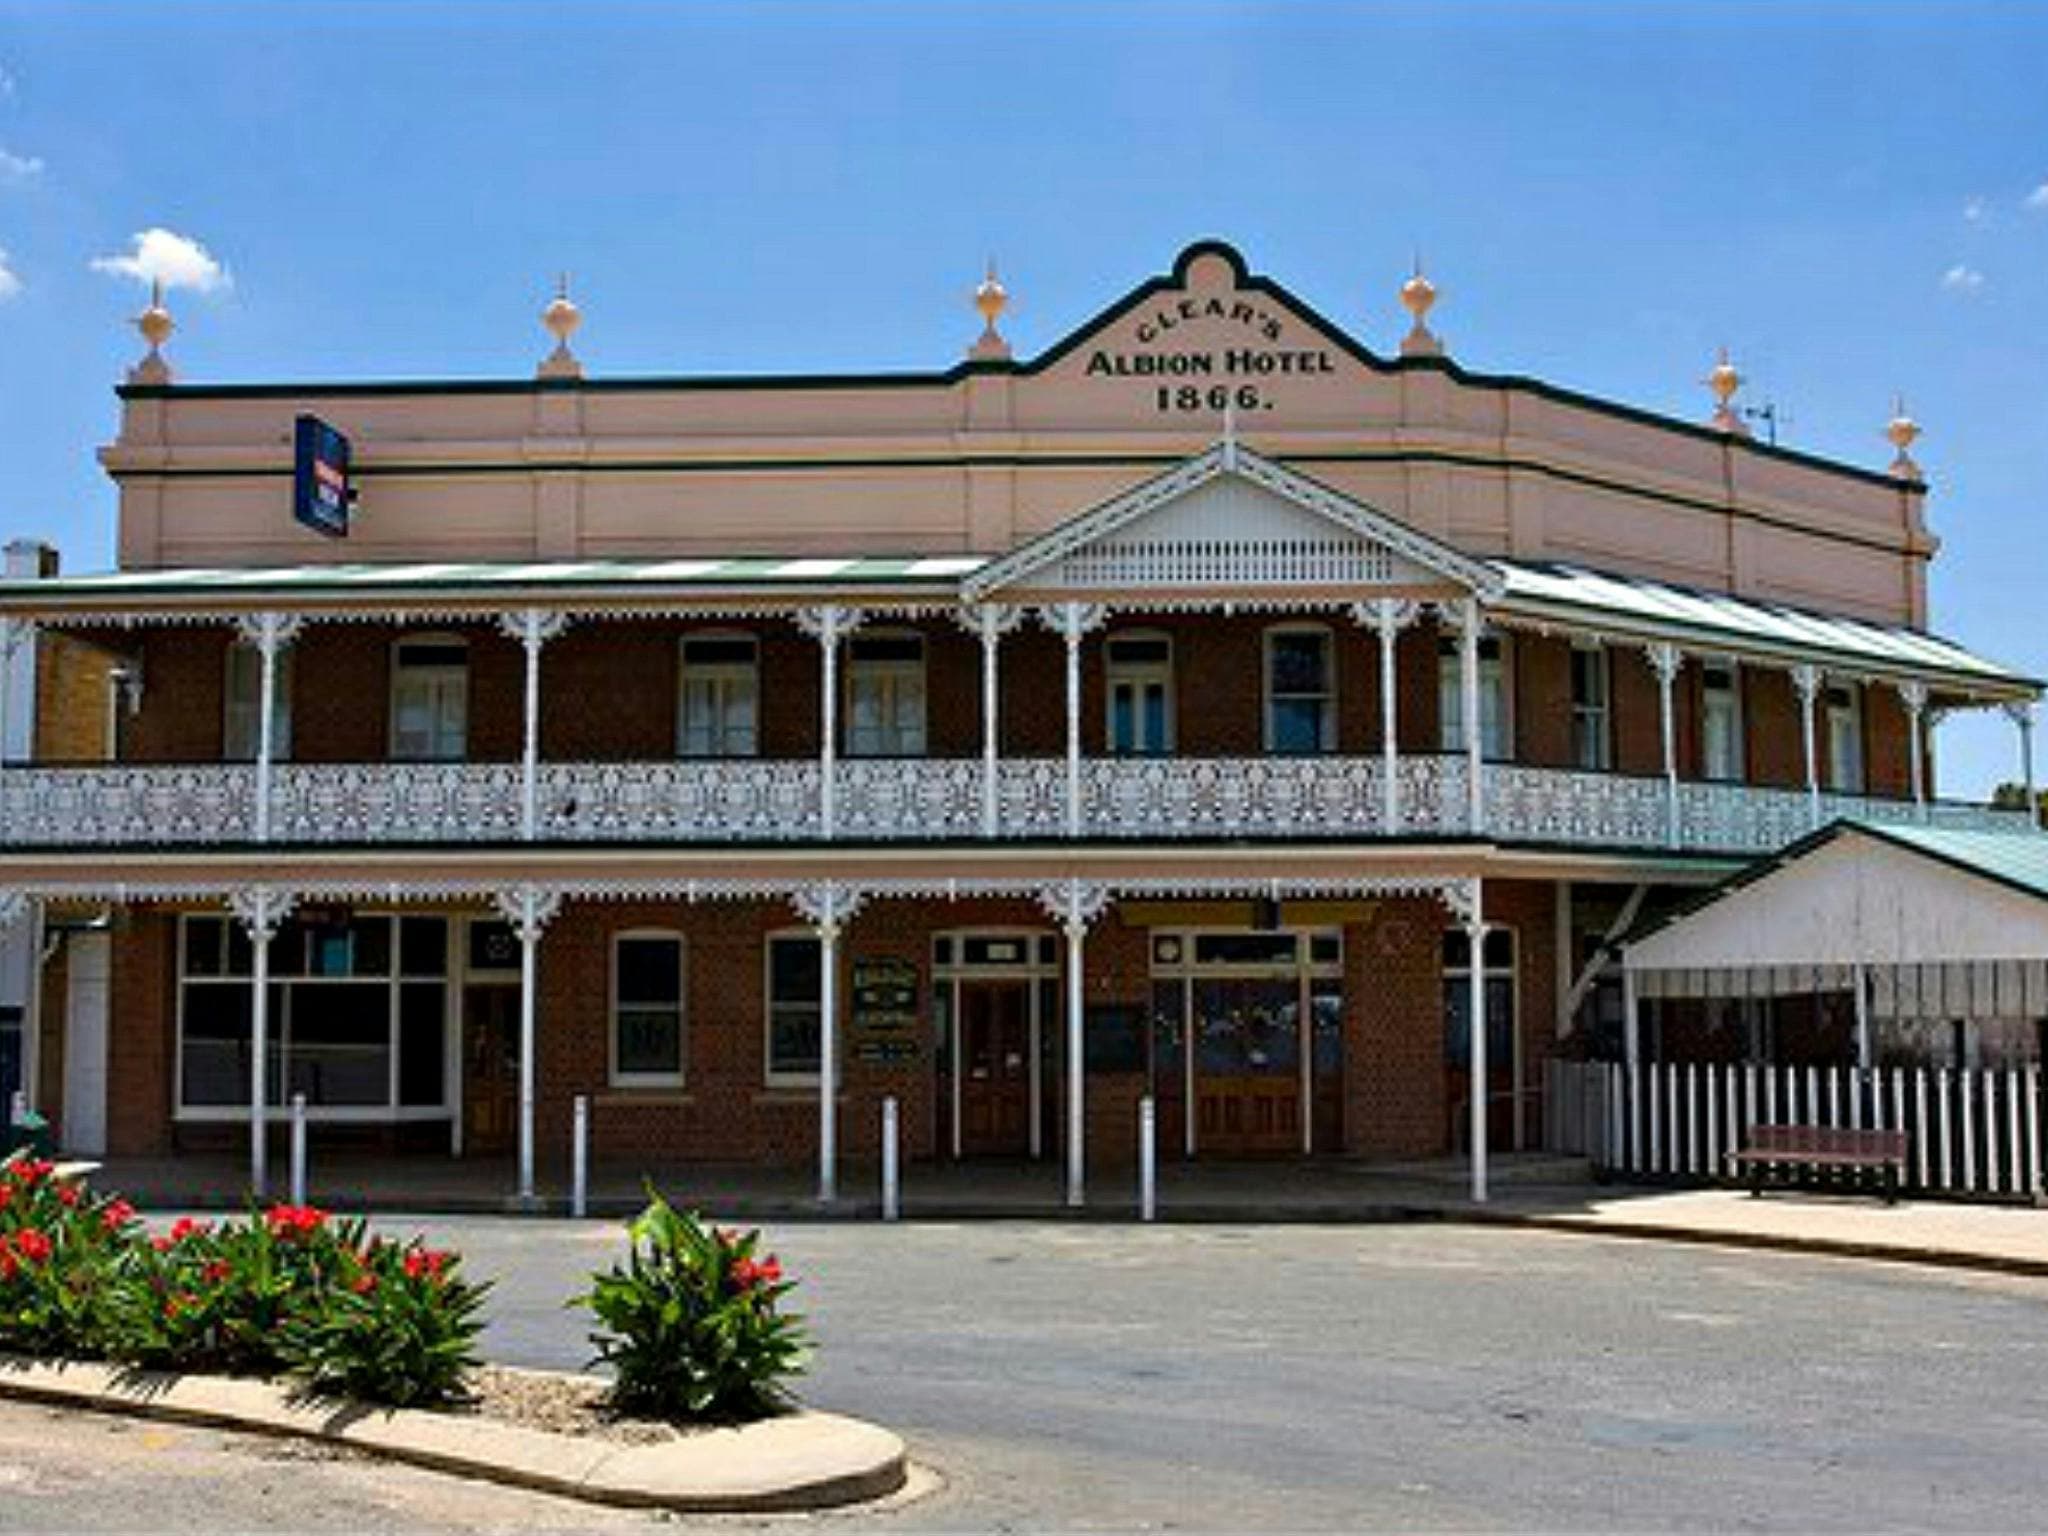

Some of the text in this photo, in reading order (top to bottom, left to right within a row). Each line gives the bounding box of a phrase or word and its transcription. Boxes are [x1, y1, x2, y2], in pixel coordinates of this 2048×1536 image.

[1086, 351, 1334, 375] ALBION HOTEL
[1157, 385, 1273, 411] 1866.
